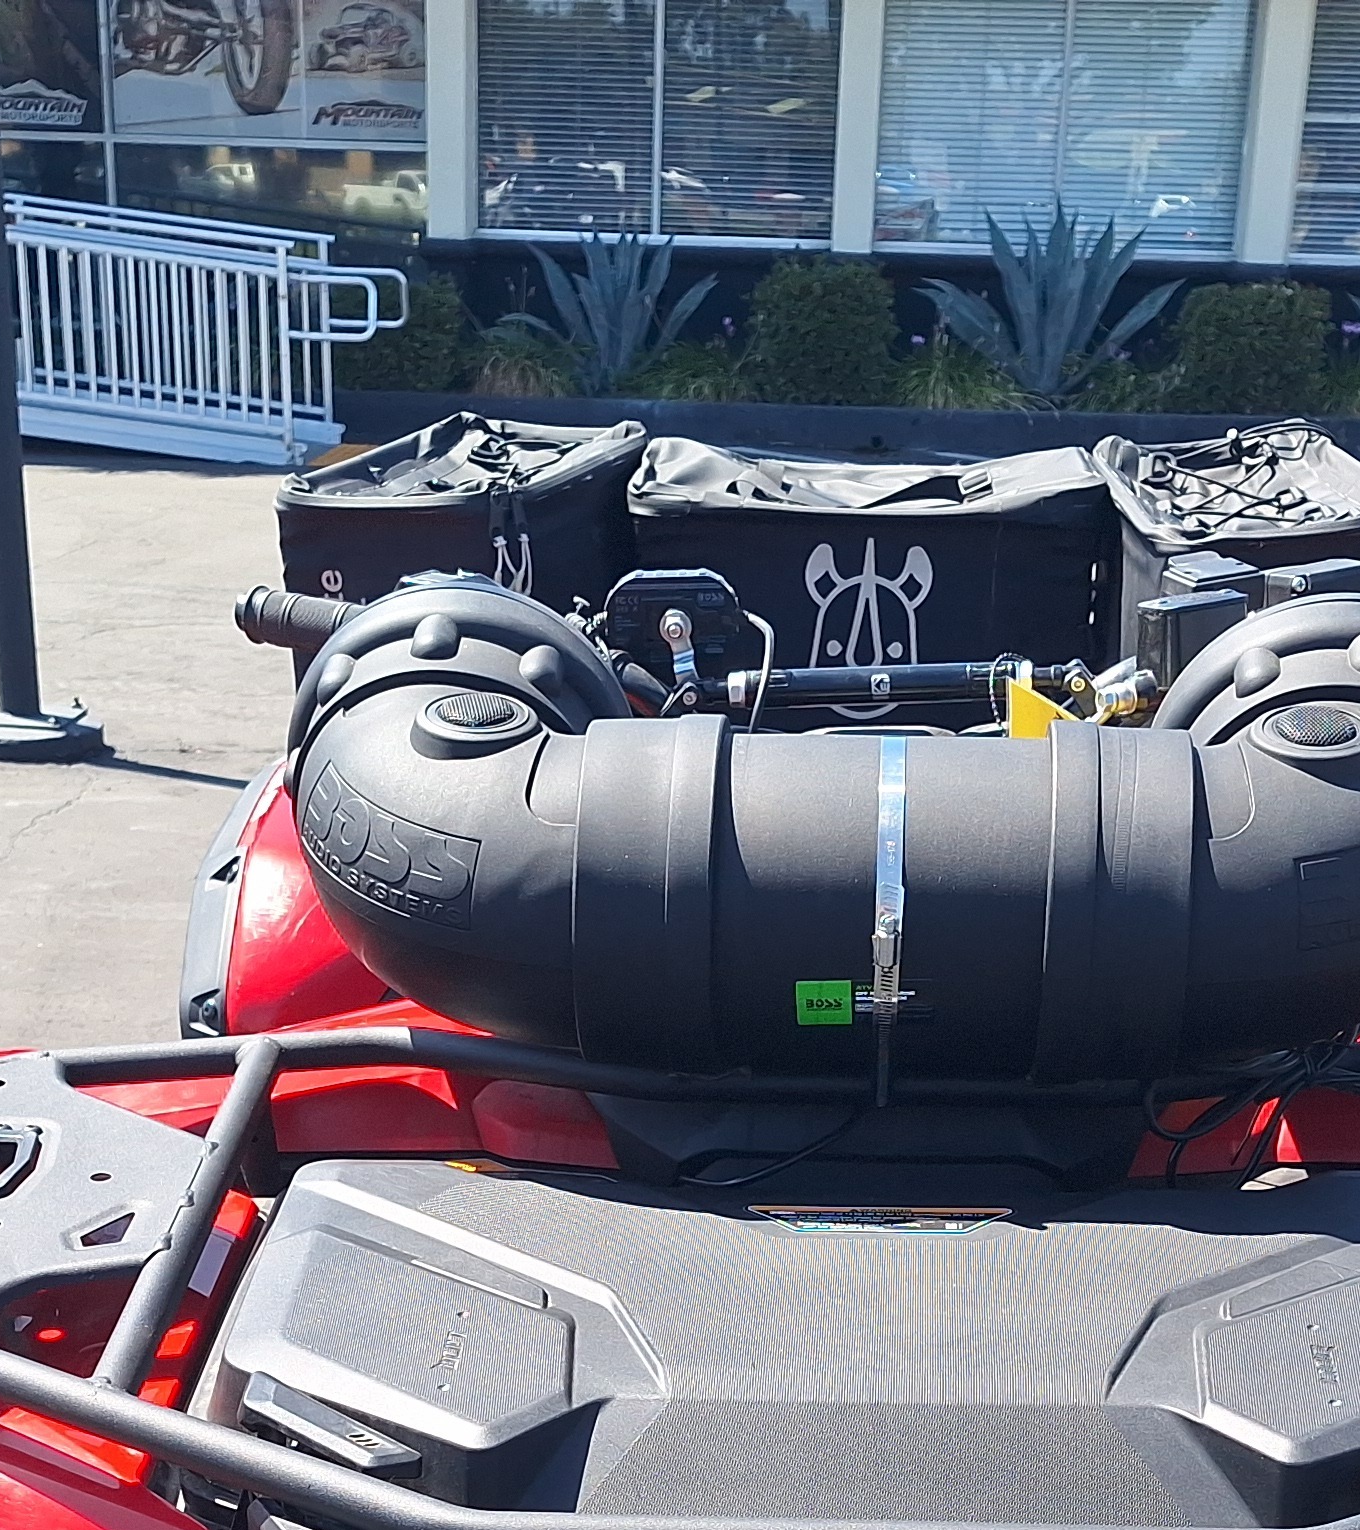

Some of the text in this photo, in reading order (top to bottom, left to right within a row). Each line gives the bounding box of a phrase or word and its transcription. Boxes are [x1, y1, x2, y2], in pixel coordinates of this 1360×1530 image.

[0, 98, 87, 114] OUNTAIN
[312, 106, 424, 126] MOUNTAIN
[304, 765, 472, 902] BOSS
[346, 868, 463, 924] SYSTEMS
[805, 998, 843, 1009] BOSS
